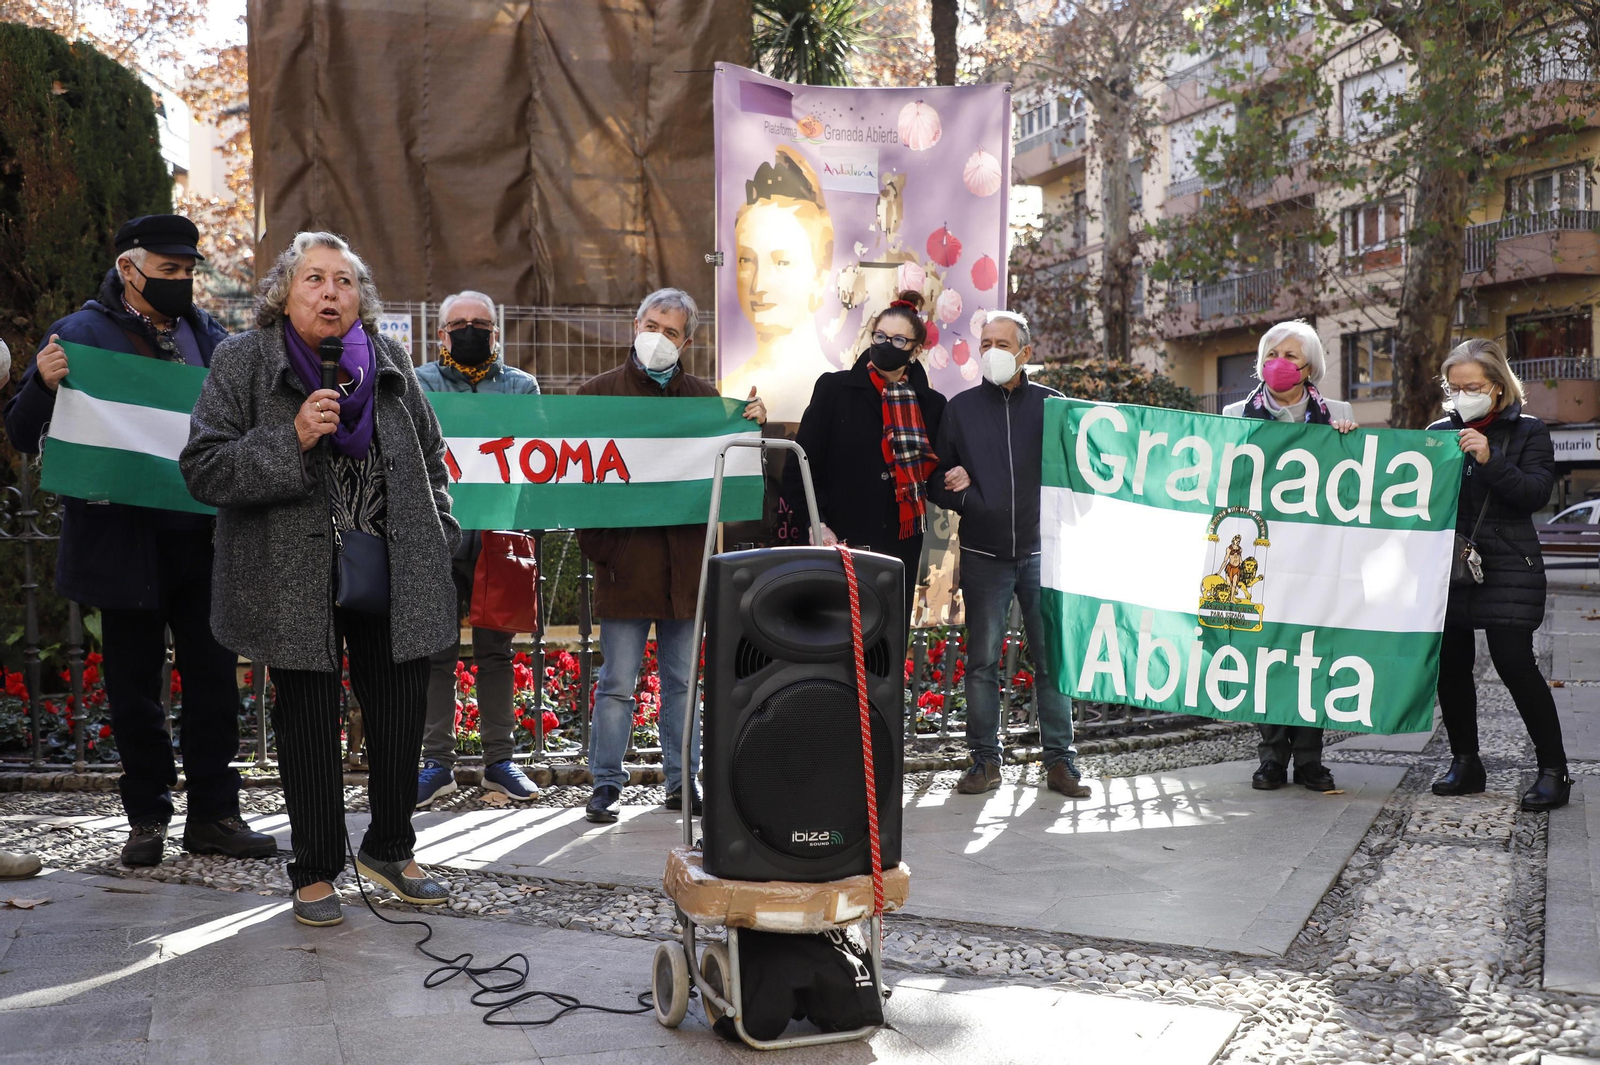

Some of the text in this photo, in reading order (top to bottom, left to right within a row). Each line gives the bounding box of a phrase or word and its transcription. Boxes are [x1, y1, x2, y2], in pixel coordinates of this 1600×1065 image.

[764, 120, 898, 144] Plataforma Granada Abierta
[823, 162, 876, 179] Andalucía
[478, 435, 630, 485] TOMA
[1075, 405, 1433, 525] Granada
[1076, 603, 1374, 728] Abierta
[792, 829, 830, 843] ibiza
